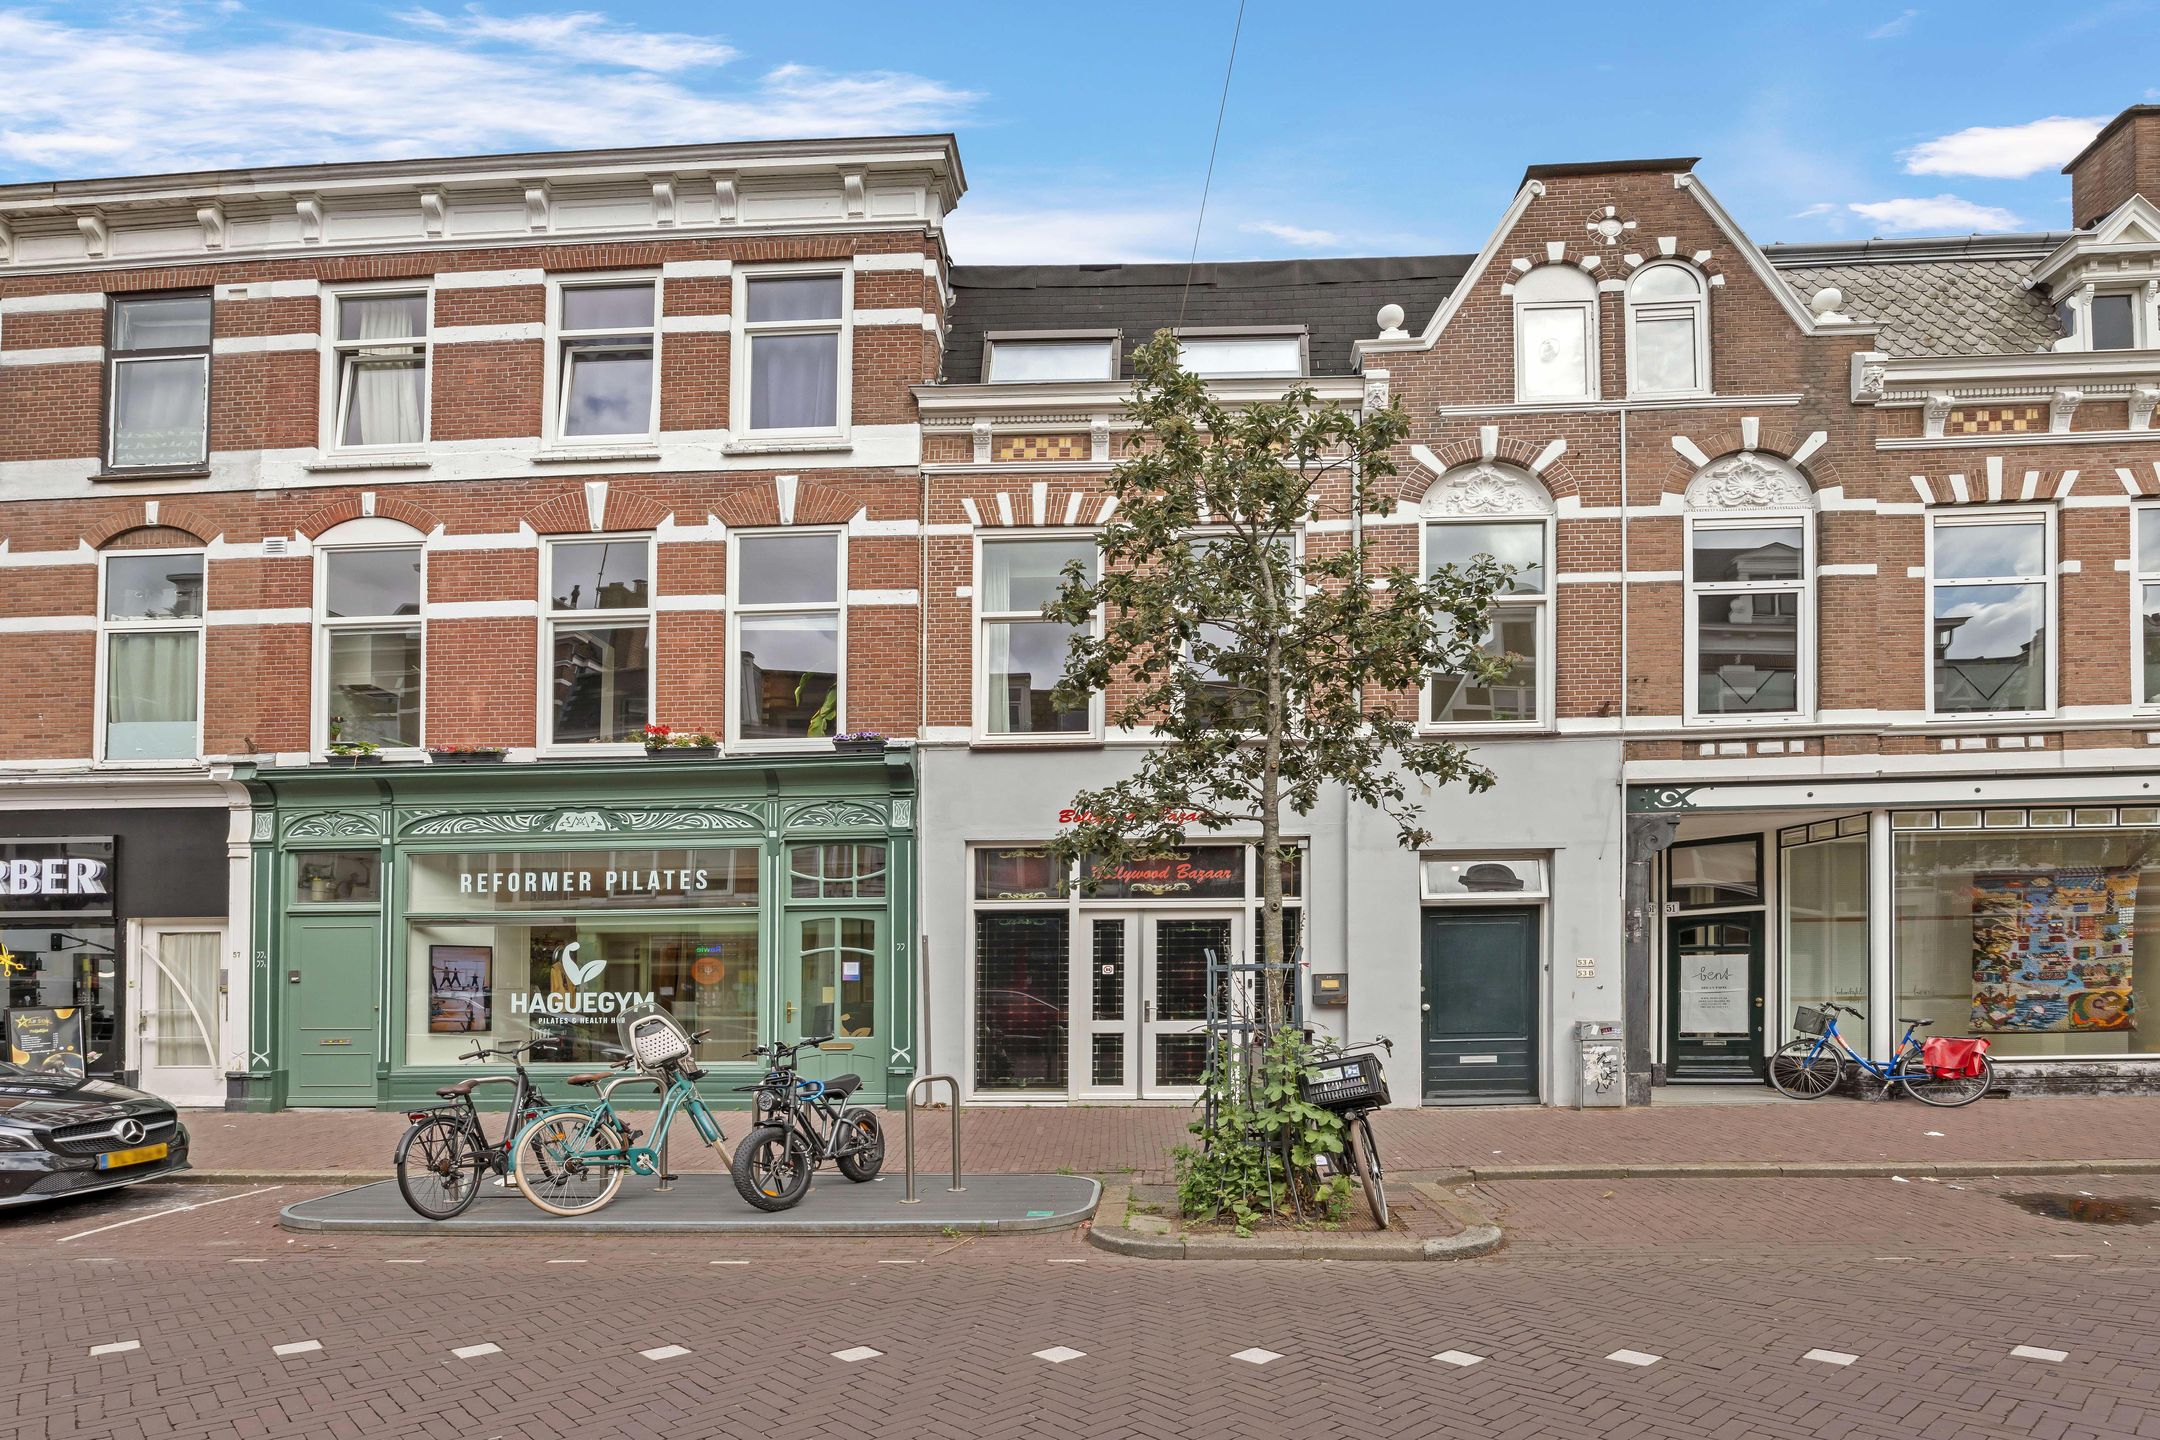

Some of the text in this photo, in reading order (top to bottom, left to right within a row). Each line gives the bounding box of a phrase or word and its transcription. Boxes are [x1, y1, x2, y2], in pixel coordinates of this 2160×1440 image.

[460, 869, 708, 893] REFORMER PILATES
[1176, 863, 1232, 884] Bazaar
[1666, 902, 1676, 913] 51
[232, 951, 241, 959] 57
[510, 991, 656, 1014] HAGUEGYM
[538, 1017, 569, 1025] PILATES
[580, 1017, 608, 1025] HEALTH
